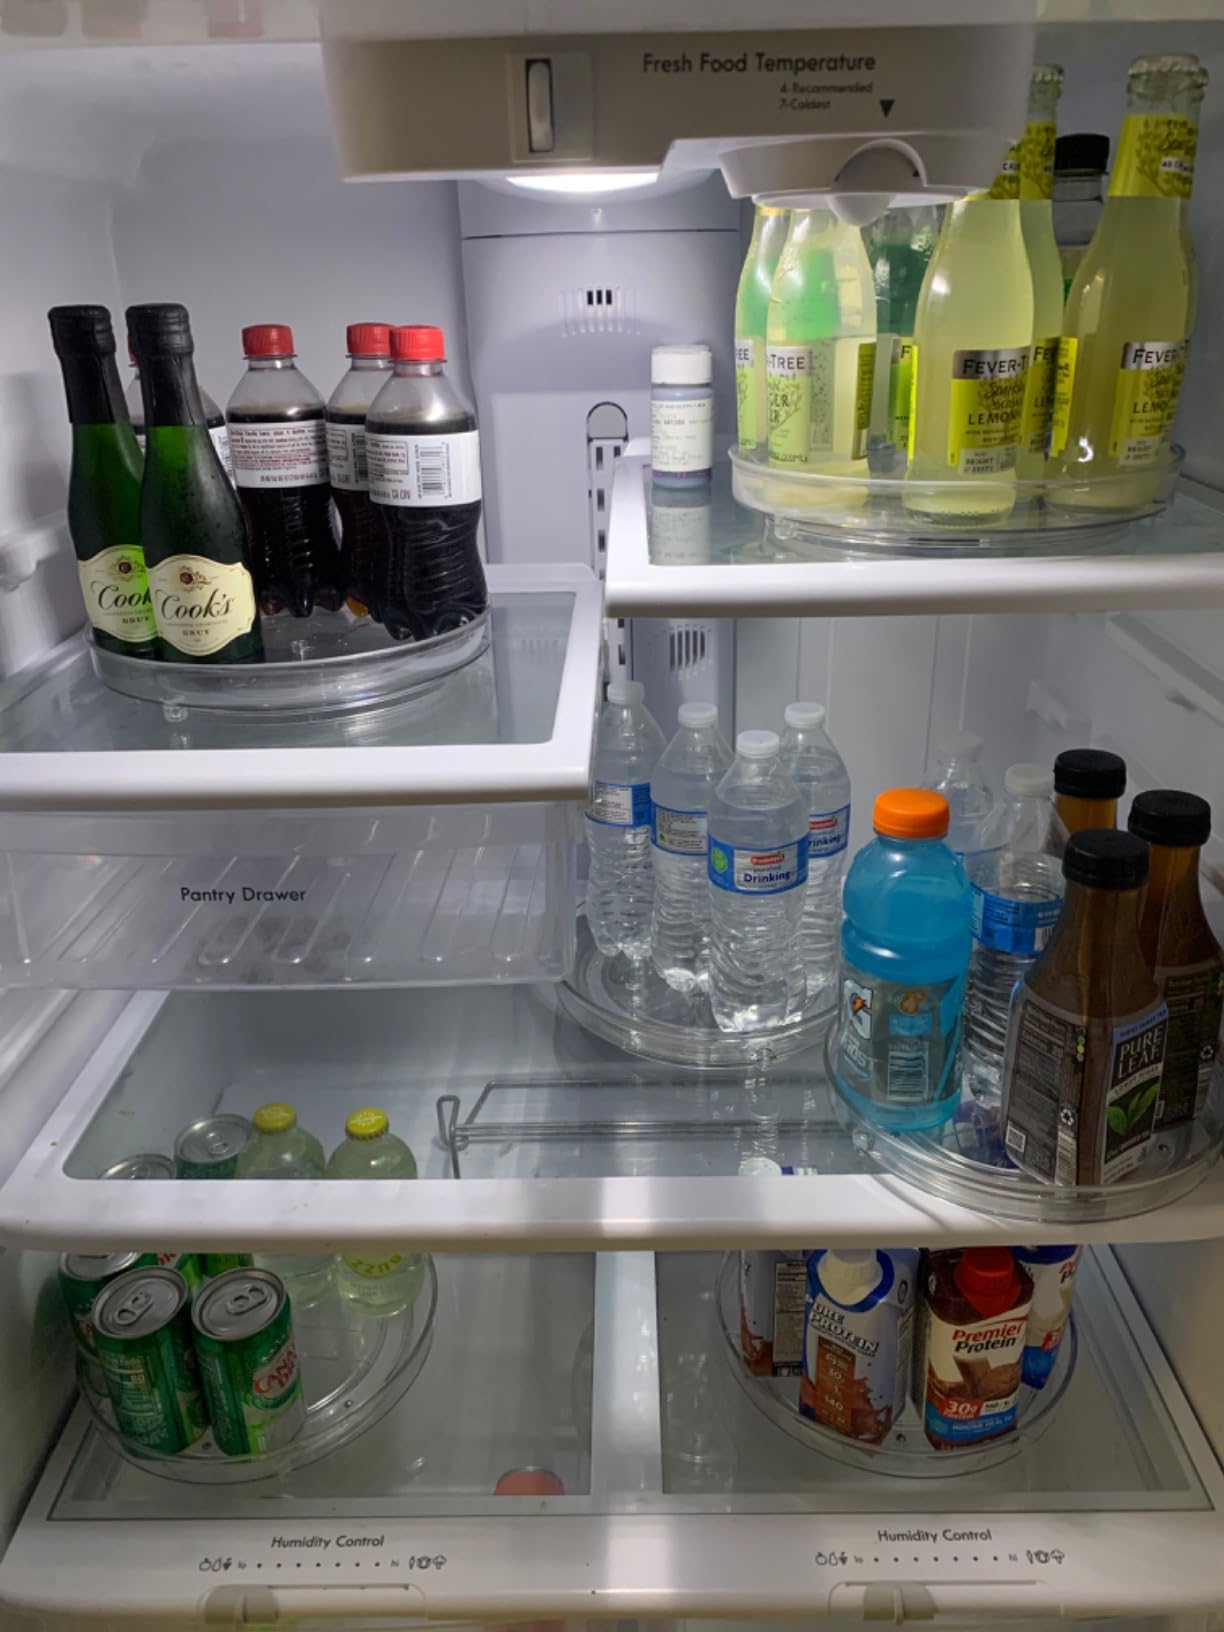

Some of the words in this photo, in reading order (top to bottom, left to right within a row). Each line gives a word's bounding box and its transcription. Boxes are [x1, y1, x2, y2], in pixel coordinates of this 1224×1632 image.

[643, 53, 692, 73] Fresh
[700, 53, 747, 73] Food
[756, 52, 876, 77] Temperature
[155, 588, 233, 621] Cook's
[743, 871, 791, 883] Drinking
[180, 886, 235, 904] Pantry
[242, 886, 306, 902] Drawer
[1119, 1024, 1163, 1062] PURE
[951, 1322, 1024, 1342] Premier
[955, 1336, 1017, 1354] Protein
[271, 1536, 331, 1549] Humidity
[335, 1535, 384, 1548] Control
[878, 1530, 938, 1543] Humidity
[942, 1529, 992, 1541] Control
